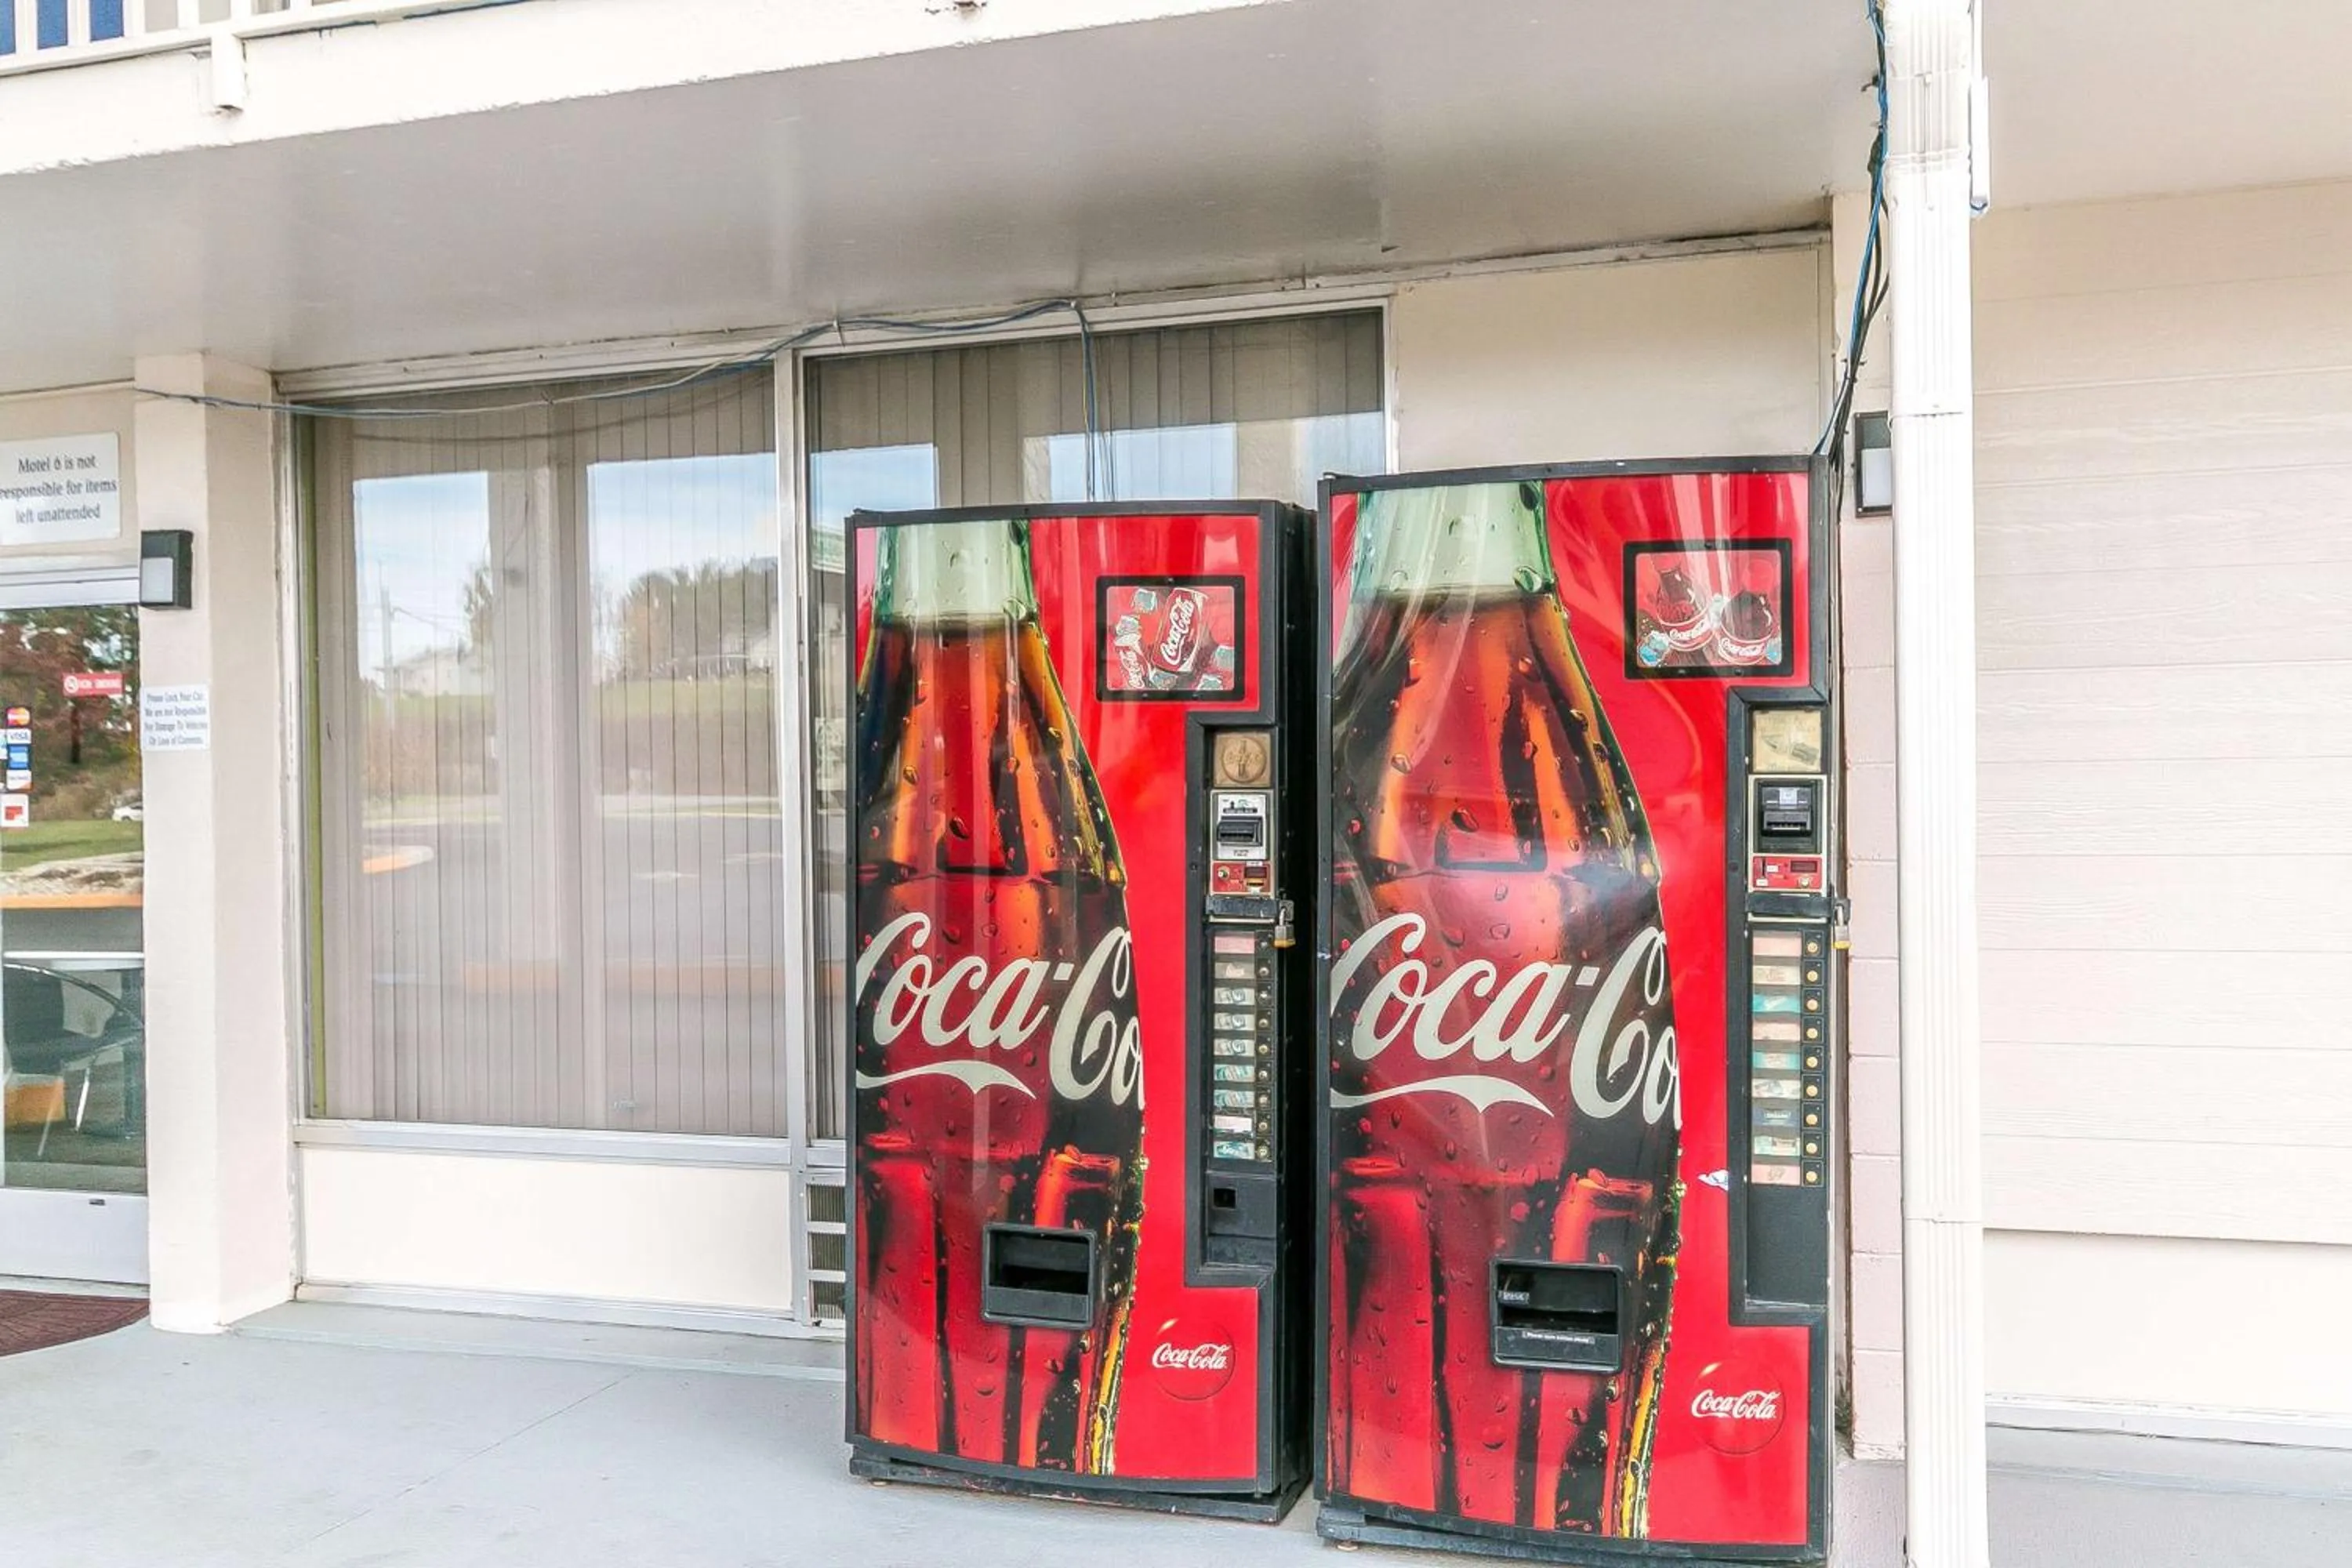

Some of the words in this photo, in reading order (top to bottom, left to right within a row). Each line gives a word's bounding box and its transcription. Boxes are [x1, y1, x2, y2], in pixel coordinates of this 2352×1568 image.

[18, 457, 50, 474] Motel
[54, 456, 62, 470] 6
[64, 455, 74, 470] is
[77, 455, 96, 469] not
[67, 479, 83, 495] for
[85, 479, 117, 493] items
[16, 508, 34, 524] left
[37, 503, 100, 522] unattended
[855, 912, 1145, 1110] Coca-Co
[1330, 913, 1682, 1130] Coca-Co
[1152, 1341, 1232, 1370] Coca-Cola
[1691, 1388, 1781, 1420] Coca-Cola
